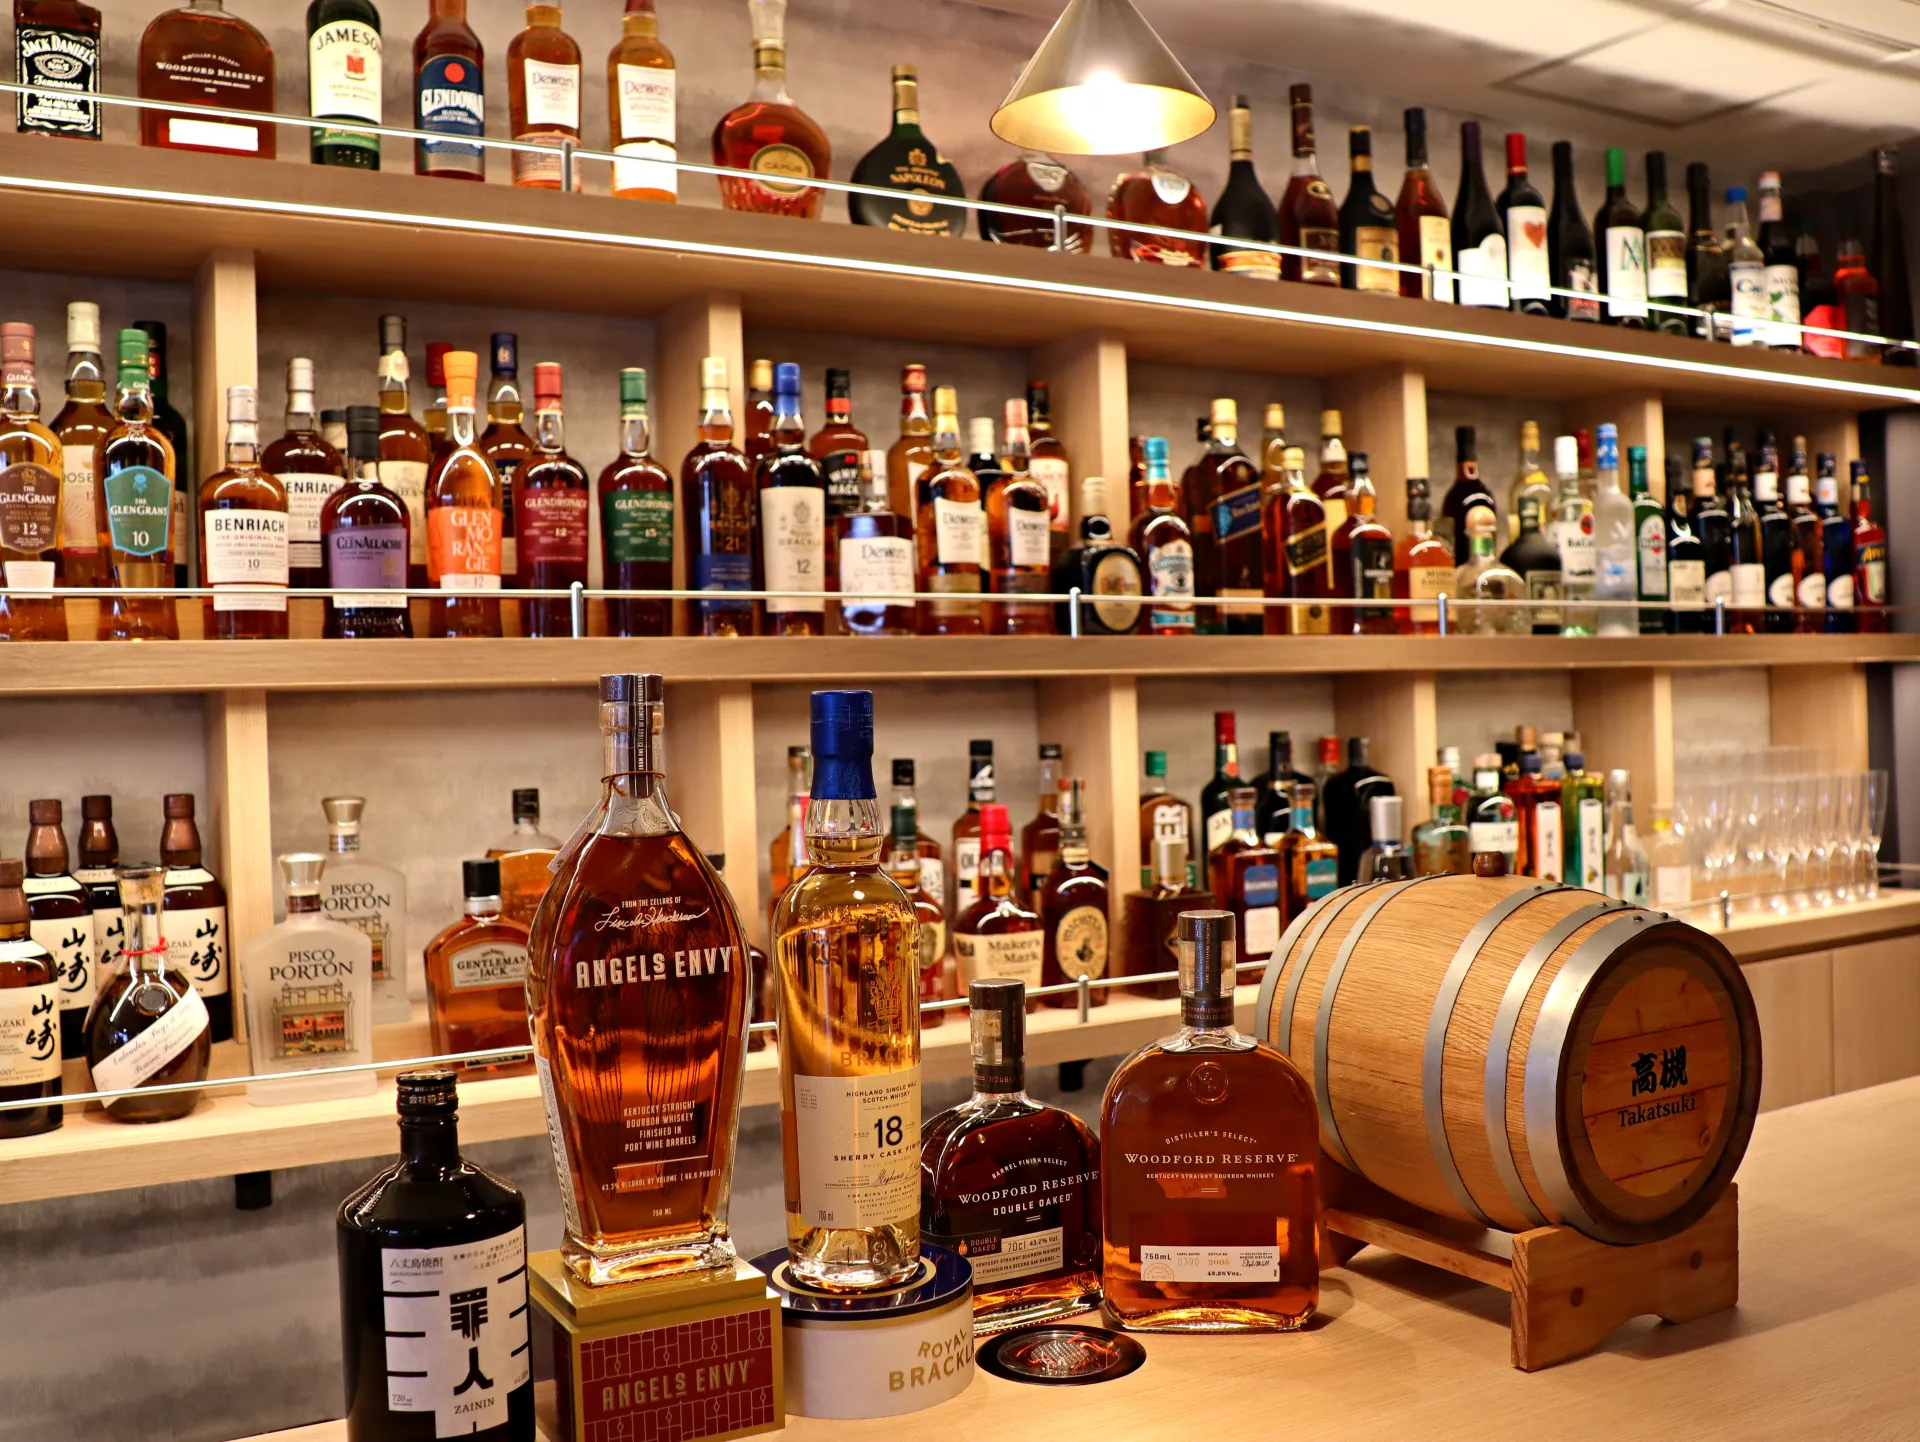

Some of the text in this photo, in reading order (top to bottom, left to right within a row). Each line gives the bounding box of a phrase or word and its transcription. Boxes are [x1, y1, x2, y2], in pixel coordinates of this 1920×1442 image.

[21, 34, 97, 66] JACK DANIEL'S
[156, 61, 215, 76] WOODFORD
[217, 68, 265, 83] RESERVE
[33, 75, 84, 90] Tennessee
[285, 481, 340, 495] ENRIAC
[215, 518, 285, 533] BENRIACH
[307, 519, 318, 529] 12
[451, 511, 492, 527] GLEN
[23, 522, 38, 536] 12
[466, 526, 493, 539] MO
[132, 530, 150, 547] 10
[724, 536, 740, 551] 21
[452, 541, 485, 557] RAN
[248, 559, 260, 568] 10
[466, 556, 491, 572] GIE
[796, 559, 811, 574] 12
[473, 576, 485, 588] 12
[331, 882, 375, 897] PISCO
[622, 896, 681, 909] FROM THE CELLARS OF
[190, 918, 222, 982] 山崎
[288, 948, 335, 965] PISCO
[1004, 949, 1040, 963] Mark
[457, 954, 527, 970] GENTLEMAN
[674, 946, 733, 978] ENVY
[480, 967, 507, 978] JACK
[26, 994, 57, 1061] 山崎
[1631, 1044, 1689, 1097] 高槻
[846, 1084, 906, 1097] HIGHLAND SINGLE
[862, 1091, 911, 1104] SCOTCH WHISKY
[623, 1100, 696, 1117] KENTUCKY STRAIGHT
[1617, 1091, 1697, 1128] Takatsuki
[626, 1112, 694, 1129] BOURBON WHISKEY
[639, 1125, 682, 1139] FINISHED IN
[874, 1115, 903, 1149] 18
[1165, 1130, 1254, 1145] DISTILLER'S SELECT
[624, 1135, 697, 1152] PORT WINE BARRELS
[833, 1148, 902, 1162] SHERRY CASK
[1125, 1153, 1297, 1164] WOODFORD RESERVE
[991, 1157, 1068, 1179] BARREL FINISH SELECT
[958, 1171, 1098, 1205] WOODFORD RESERVE
[993, 1193, 1071, 1216] DOUBLE OAKED
[970, 1236, 998, 1247] DOUBLE
[972, 1244, 996, 1254] OAKED
[1007, 1240, 1026, 1252] 70cl
[1029, 1238, 1048, 1246] 43.2%
[390, 1256, 444, 1269] 八丈島焼酎
[976, 1259, 1000, 1268] KENTUCKY
[1000, 1255, 1021, 1265] STRAIGHT
[1022, 1251, 1042, 1260] BOURBON
[1178, 1257, 1200, 1267] 0390
[982, 1266, 1003, 1275] FINISHED
[1013, 1261, 1030, 1269] SECOND
[918, 1328, 968, 1358] ROYAL
[695, 1358, 750, 1393] ENVY
[392, 1394, 406, 1402] 720
[453, 1396, 495, 1414] ZAININ
